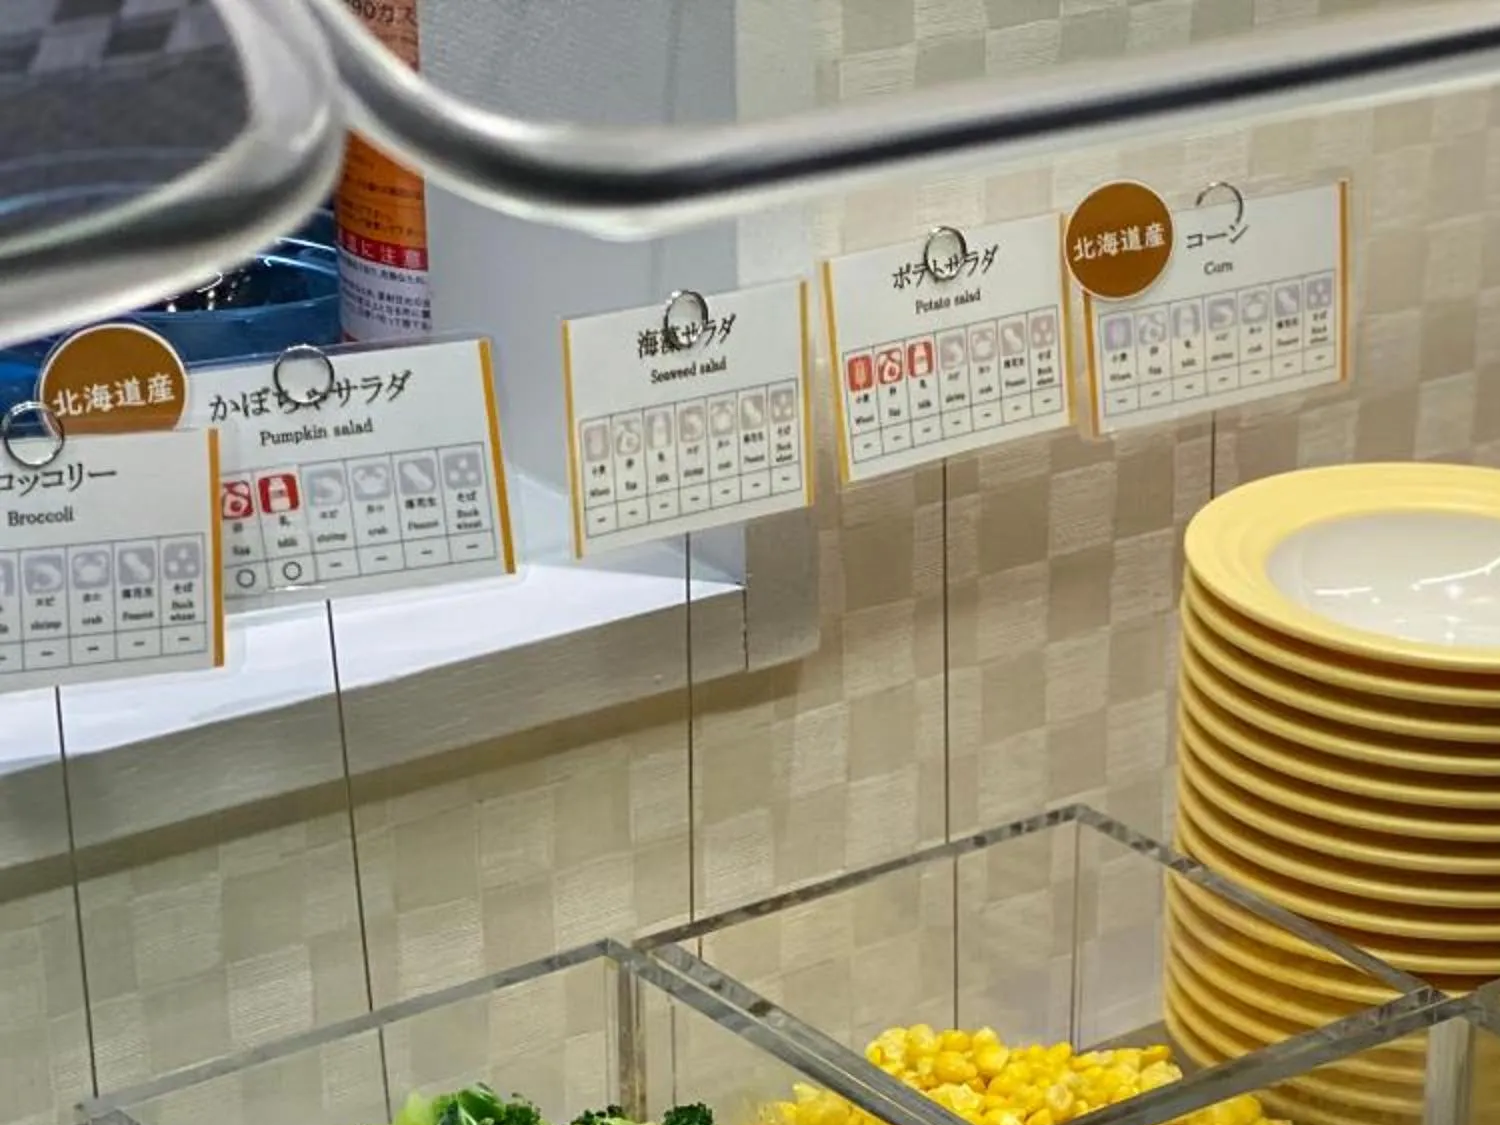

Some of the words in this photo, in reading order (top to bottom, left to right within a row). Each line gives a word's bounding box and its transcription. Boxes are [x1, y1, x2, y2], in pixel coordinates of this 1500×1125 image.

[1073, 222, 1166, 262] 北海道産
[1186, 224, 1249, 250] コーン
[892, 243, 999, 289] ポテトサラダ
[1203, 260, 1235, 276] Corn
[915, 296, 951, 315] Potato
[953, 287, 982, 307] salad
[637, 312, 737, 359] 海藻サラダ
[650, 360, 697, 384] Seaweed
[699, 354, 728, 375] salad
[52, 373, 175, 417] 北海道産
[209, 369, 412, 422] かぼちゃサラダ
[259, 426, 328, 447] Pumpkin
[333, 417, 374, 437] salad
[7, 505, 75, 528] Broccoli
